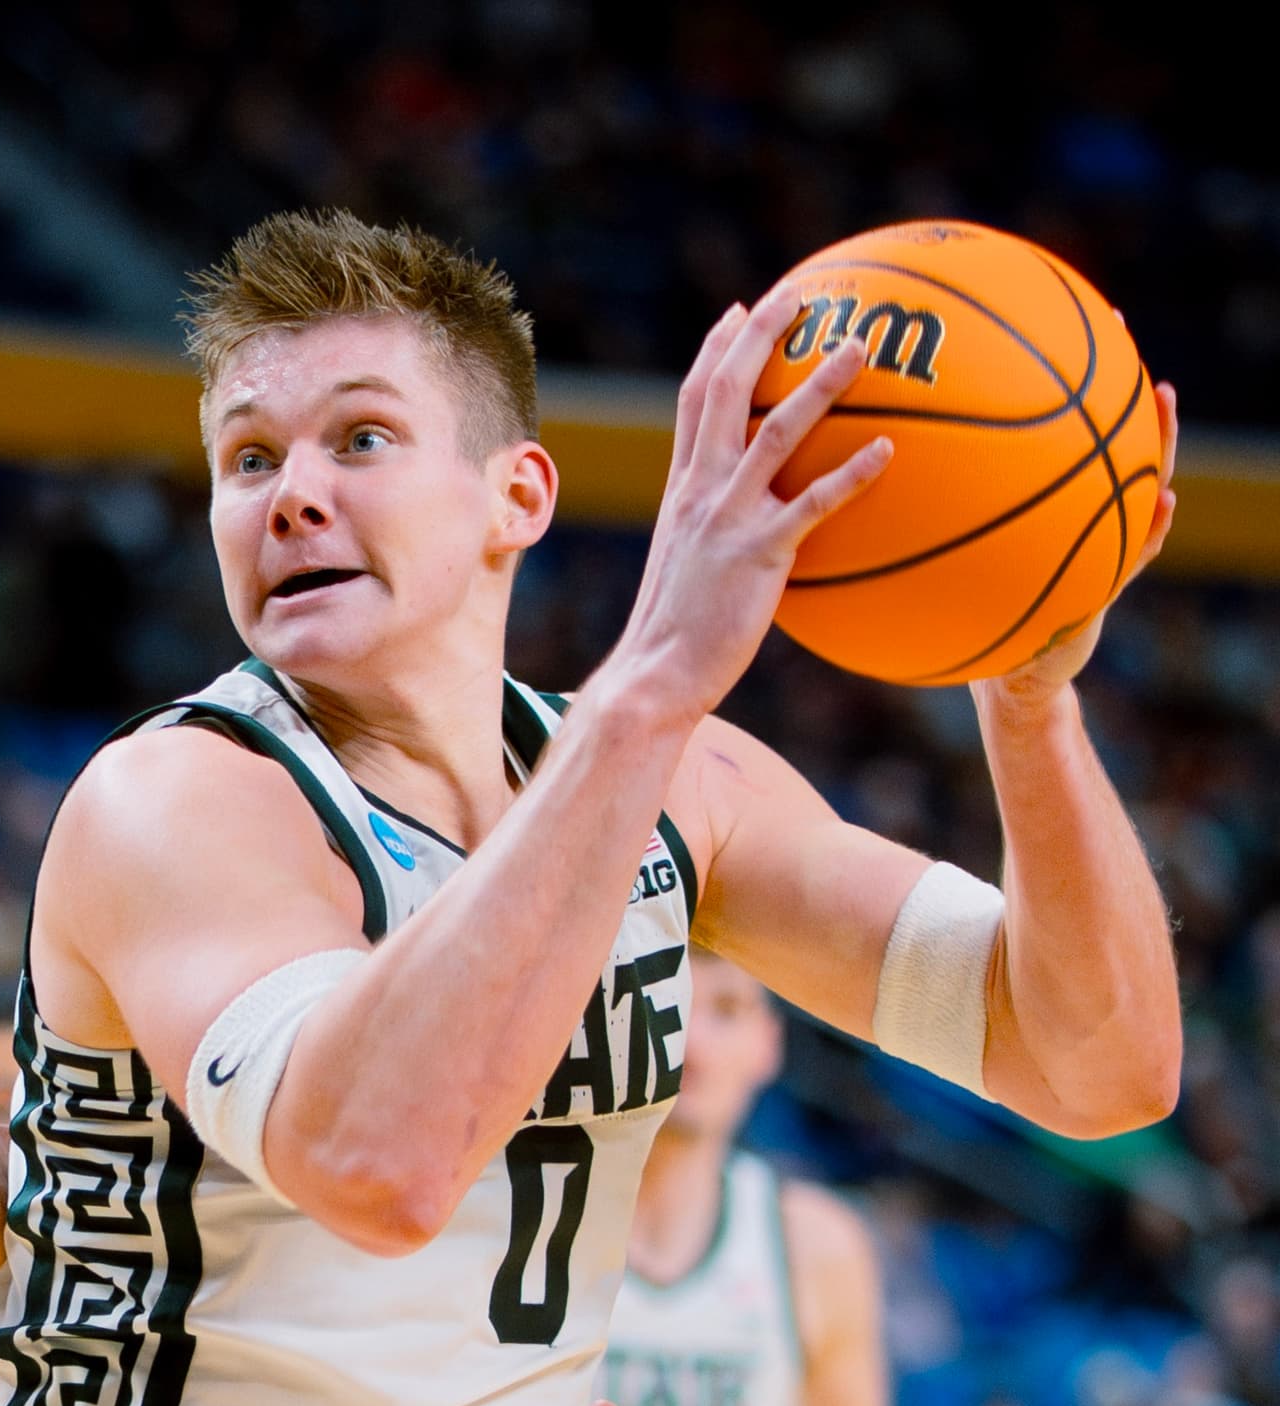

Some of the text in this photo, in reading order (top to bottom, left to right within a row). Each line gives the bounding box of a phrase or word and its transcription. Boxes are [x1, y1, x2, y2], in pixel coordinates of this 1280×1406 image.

[784, 297, 945, 387] Wil
[523, 943, 686, 1121] ATE
[488, 1123, 595, 1346] 0
